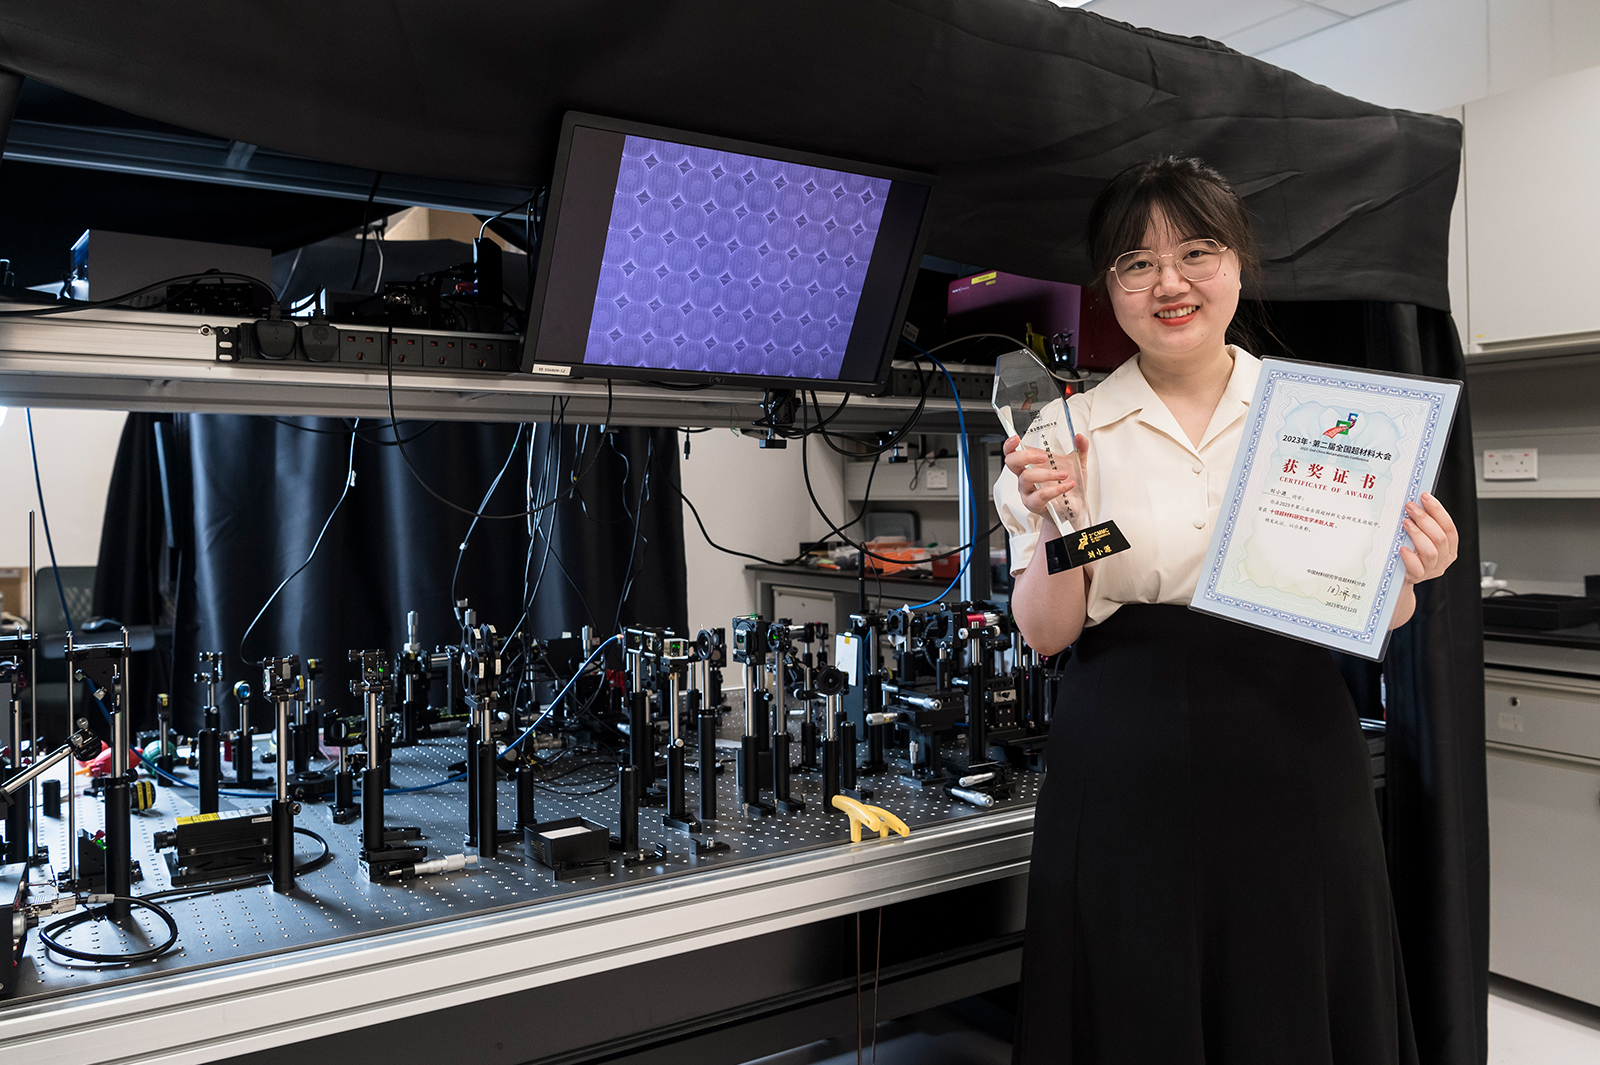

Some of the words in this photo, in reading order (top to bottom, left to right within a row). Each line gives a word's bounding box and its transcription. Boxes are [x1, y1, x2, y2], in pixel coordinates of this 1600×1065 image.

[1282, 434, 1392, 461] 2023年·第二届全国超材料大会
[1282, 458, 1376, 489] 获奖证书
[1279, 476, 1327, 491] CERTIFICATE
[1331, 486, 1341, 494] OF
[1344, 489, 1374, 501] AWARD
